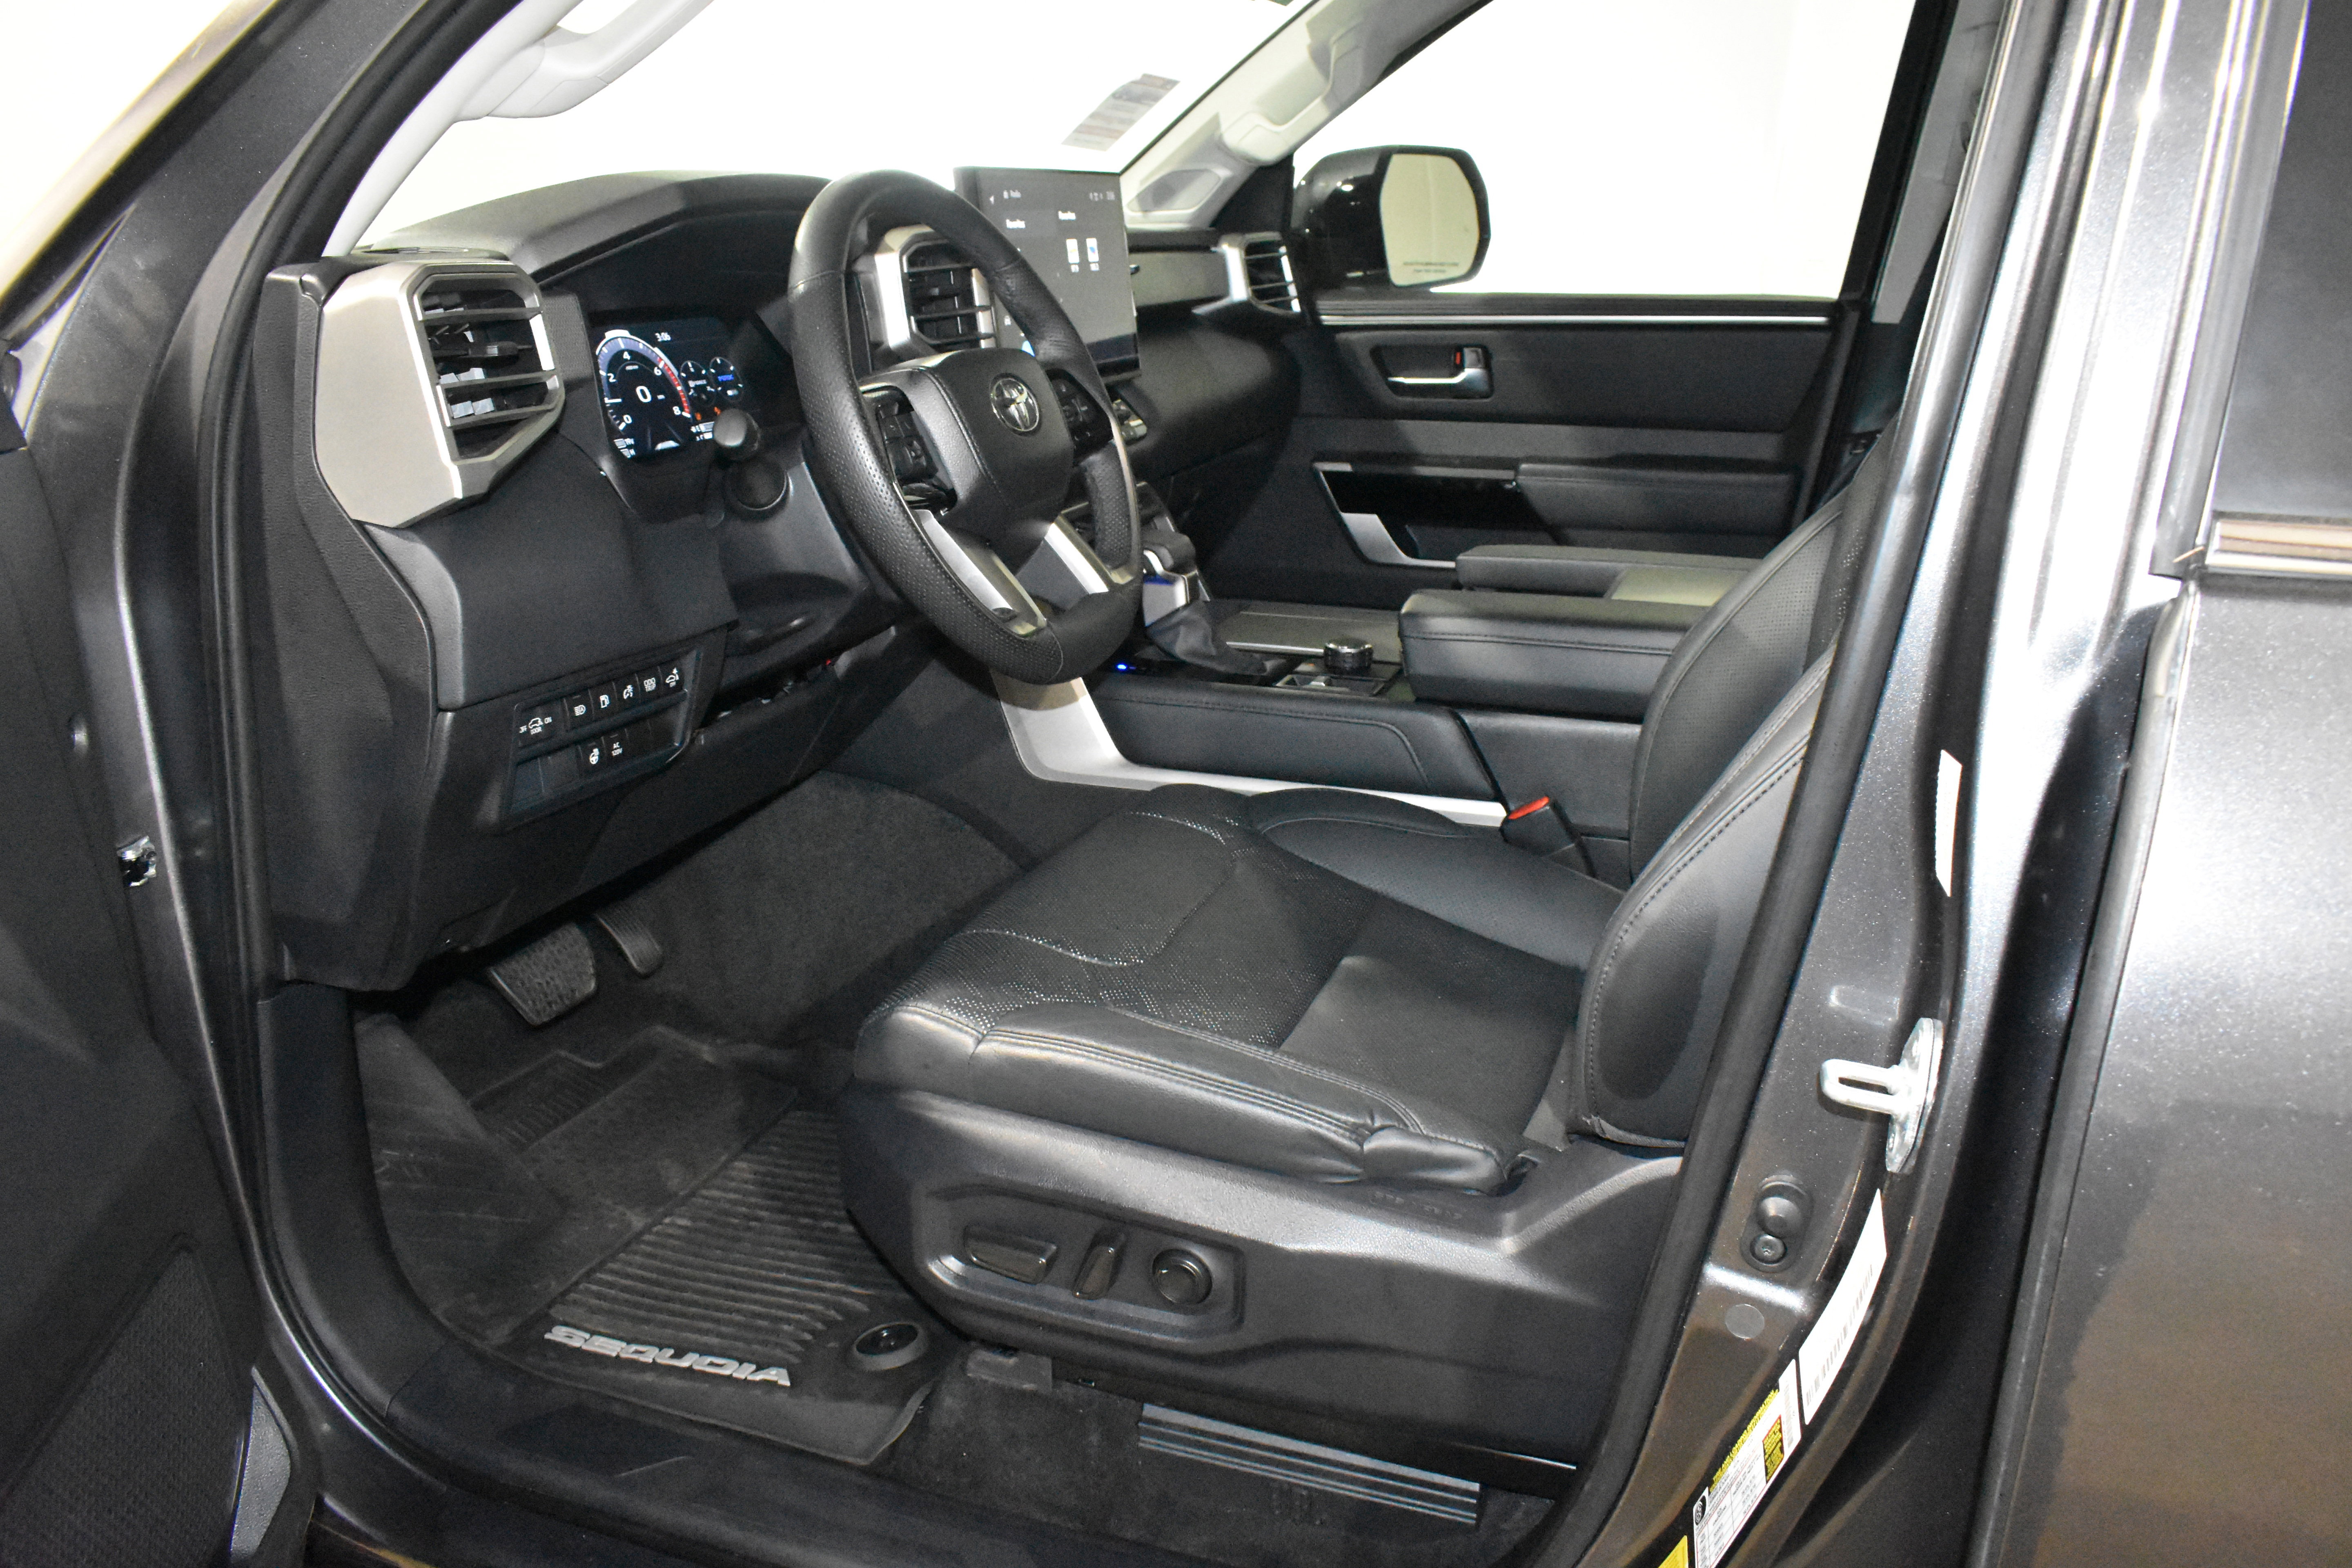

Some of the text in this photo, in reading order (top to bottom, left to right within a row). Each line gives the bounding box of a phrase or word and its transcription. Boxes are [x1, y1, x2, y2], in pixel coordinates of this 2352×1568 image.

[623, 352, 630, 360] 4
[654, 367, 662, 376] 6
[607, 373, 617, 382] 2
[635, 385, 652, 403] 0
[673, 406, 681, 415] 8
[623, 414, 632, 424] 0
[645, 684, 657, 693] TRIP
[544, 1325, 791, 1387] SEQUOIA
